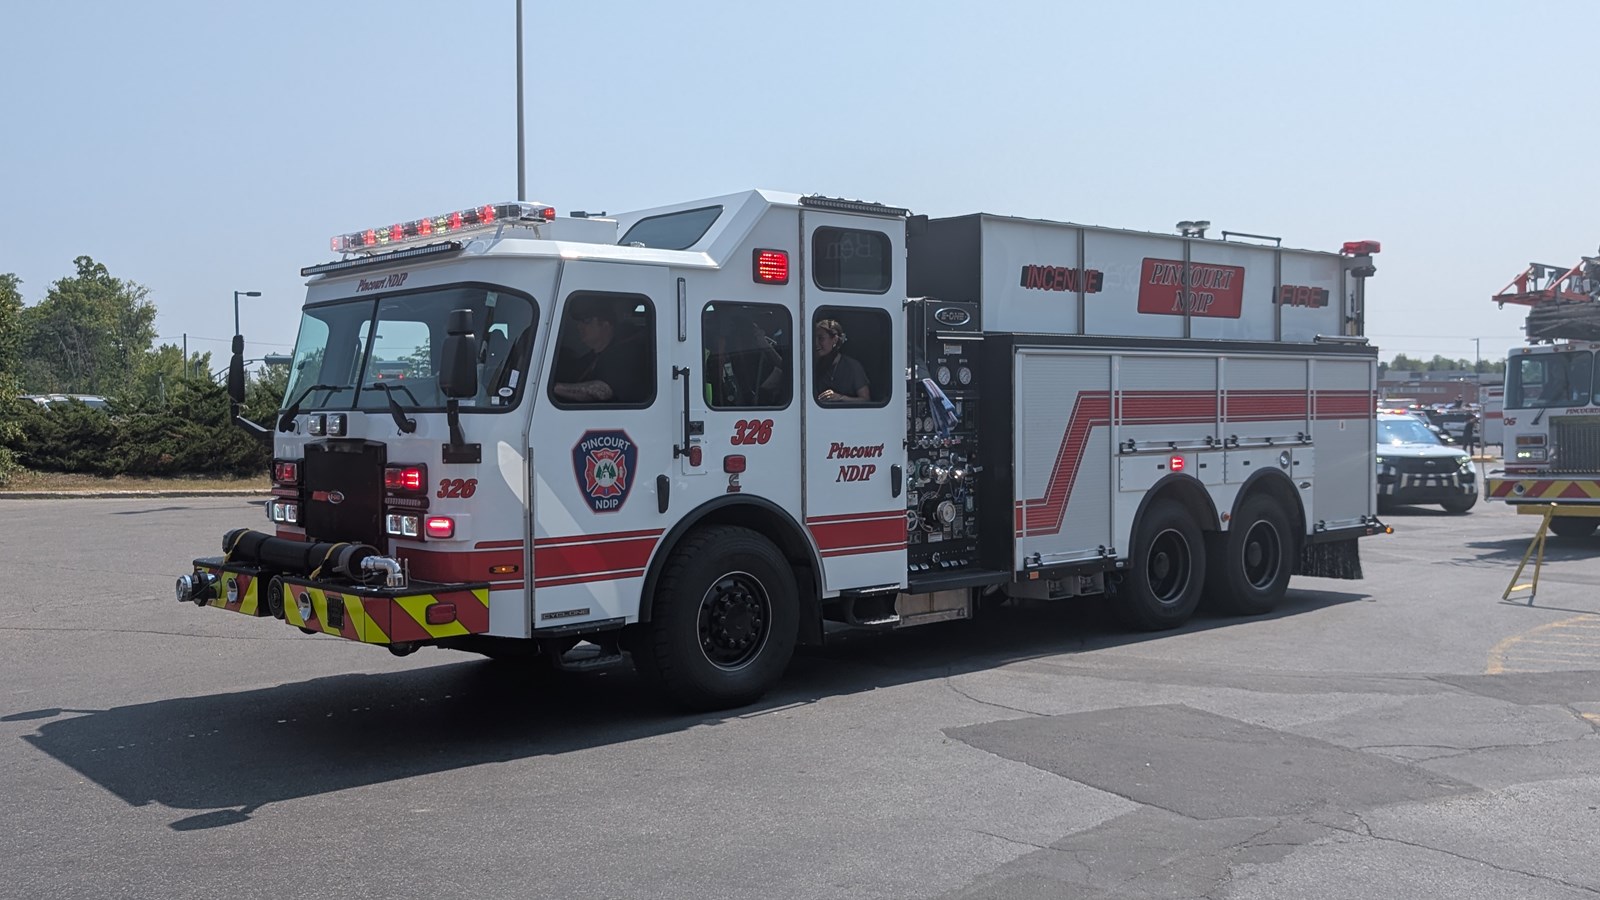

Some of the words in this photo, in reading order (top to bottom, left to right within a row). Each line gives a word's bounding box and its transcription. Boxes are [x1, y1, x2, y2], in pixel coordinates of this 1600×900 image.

[356, 277, 387, 293] Pincourt
[385, 272, 409, 288] NDIP
[1280, 284, 1323, 308] FIRE
[730, 418, 774, 446] 326
[581, 436, 631, 453] PINCOURT
[826, 442, 885, 460] Pincourt
[836, 464, 877, 483] NDIP
[436, 478, 478, 499] 326
[595, 498, 619, 510] NDIP
